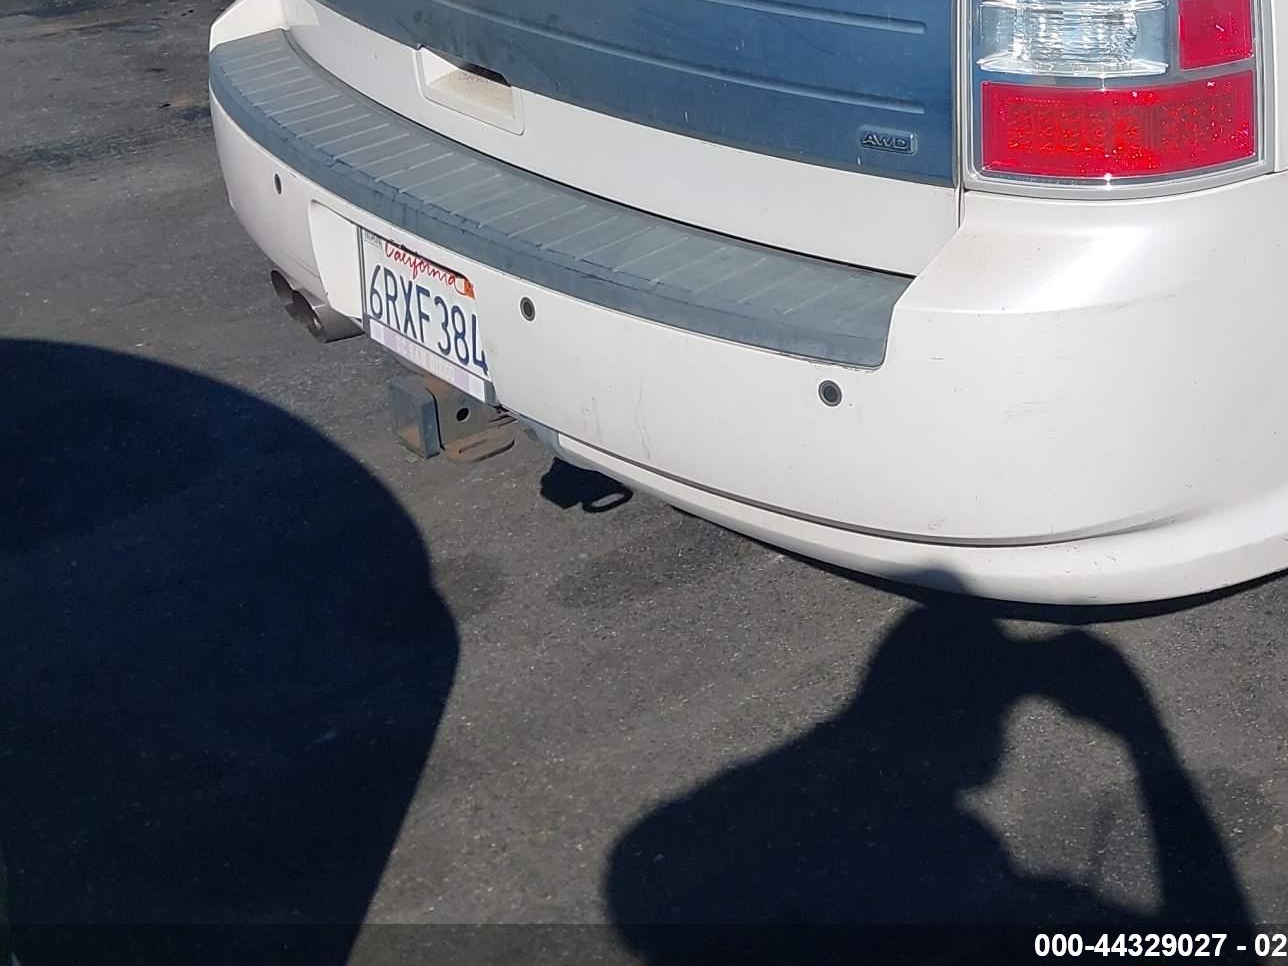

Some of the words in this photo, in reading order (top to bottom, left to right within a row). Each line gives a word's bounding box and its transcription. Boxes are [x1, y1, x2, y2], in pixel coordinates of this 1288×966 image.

[861, 130, 911, 153] AWD
[384, 239, 456, 286] California
[369, 264, 489, 376] 6RXF384
